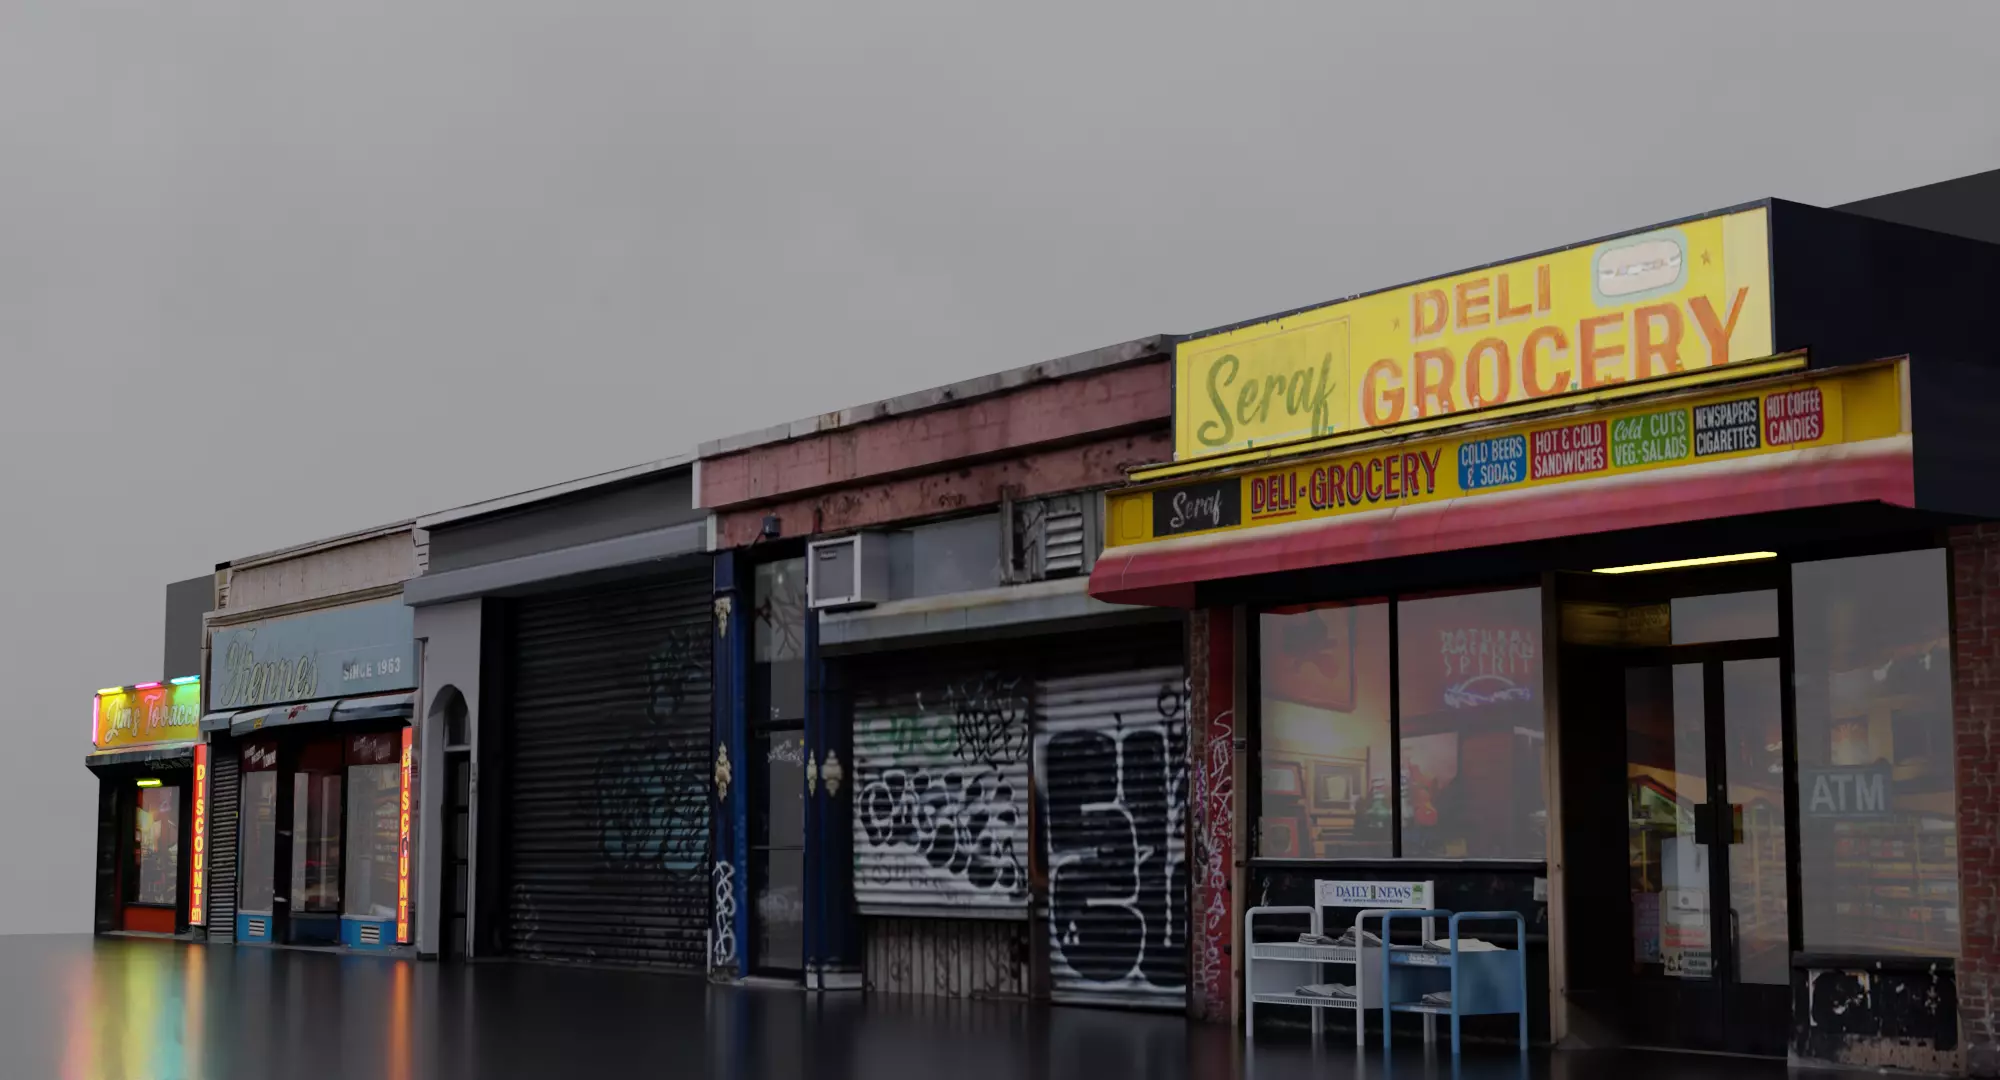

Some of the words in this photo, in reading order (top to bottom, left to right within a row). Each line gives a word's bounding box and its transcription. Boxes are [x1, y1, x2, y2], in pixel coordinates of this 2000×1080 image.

[1410, 263, 1551, 339] DELI
[1360, 286, 1749, 427] GROCERY
[1196, 352, 1336, 447] Seraf
[1695, 399, 1757, 430] NEWSPAPERS
[1766, 394, 1786, 418] HOT
[1787, 388, 1821, 416] COFFEE
[1535, 430, 1558, 454] HOT
[1562, 427, 1569, 450] &
[1573, 424, 1601, 448] COLD
[1613, 417, 1644, 443] Cold
[1651, 410, 1686, 438] CUTS
[1696, 425, 1757, 456] CIGARETTES
[1769, 415, 1820, 444] CANDIES
[1461, 443, 1488, 467] COLD
[1491, 437, 1523, 461] BEERS
[1534, 447, 1604, 479] SANDWICHES
[1467, 468, 1475, 487] &
[1480, 460, 1517, 486] SODAS
[1170, 489, 1223, 528] Seraf
[343, 662, 372, 681] SINCE
[377, 657, 401, 676] 1963
[104, 693, 140, 743] Jim's
[1809, 773, 1885, 812] ATM
[194, 763, 206, 905] DISCOUNT
[1336, 885, 1369, 898] DAILY
[1379, 886, 1411, 898] NEWS
